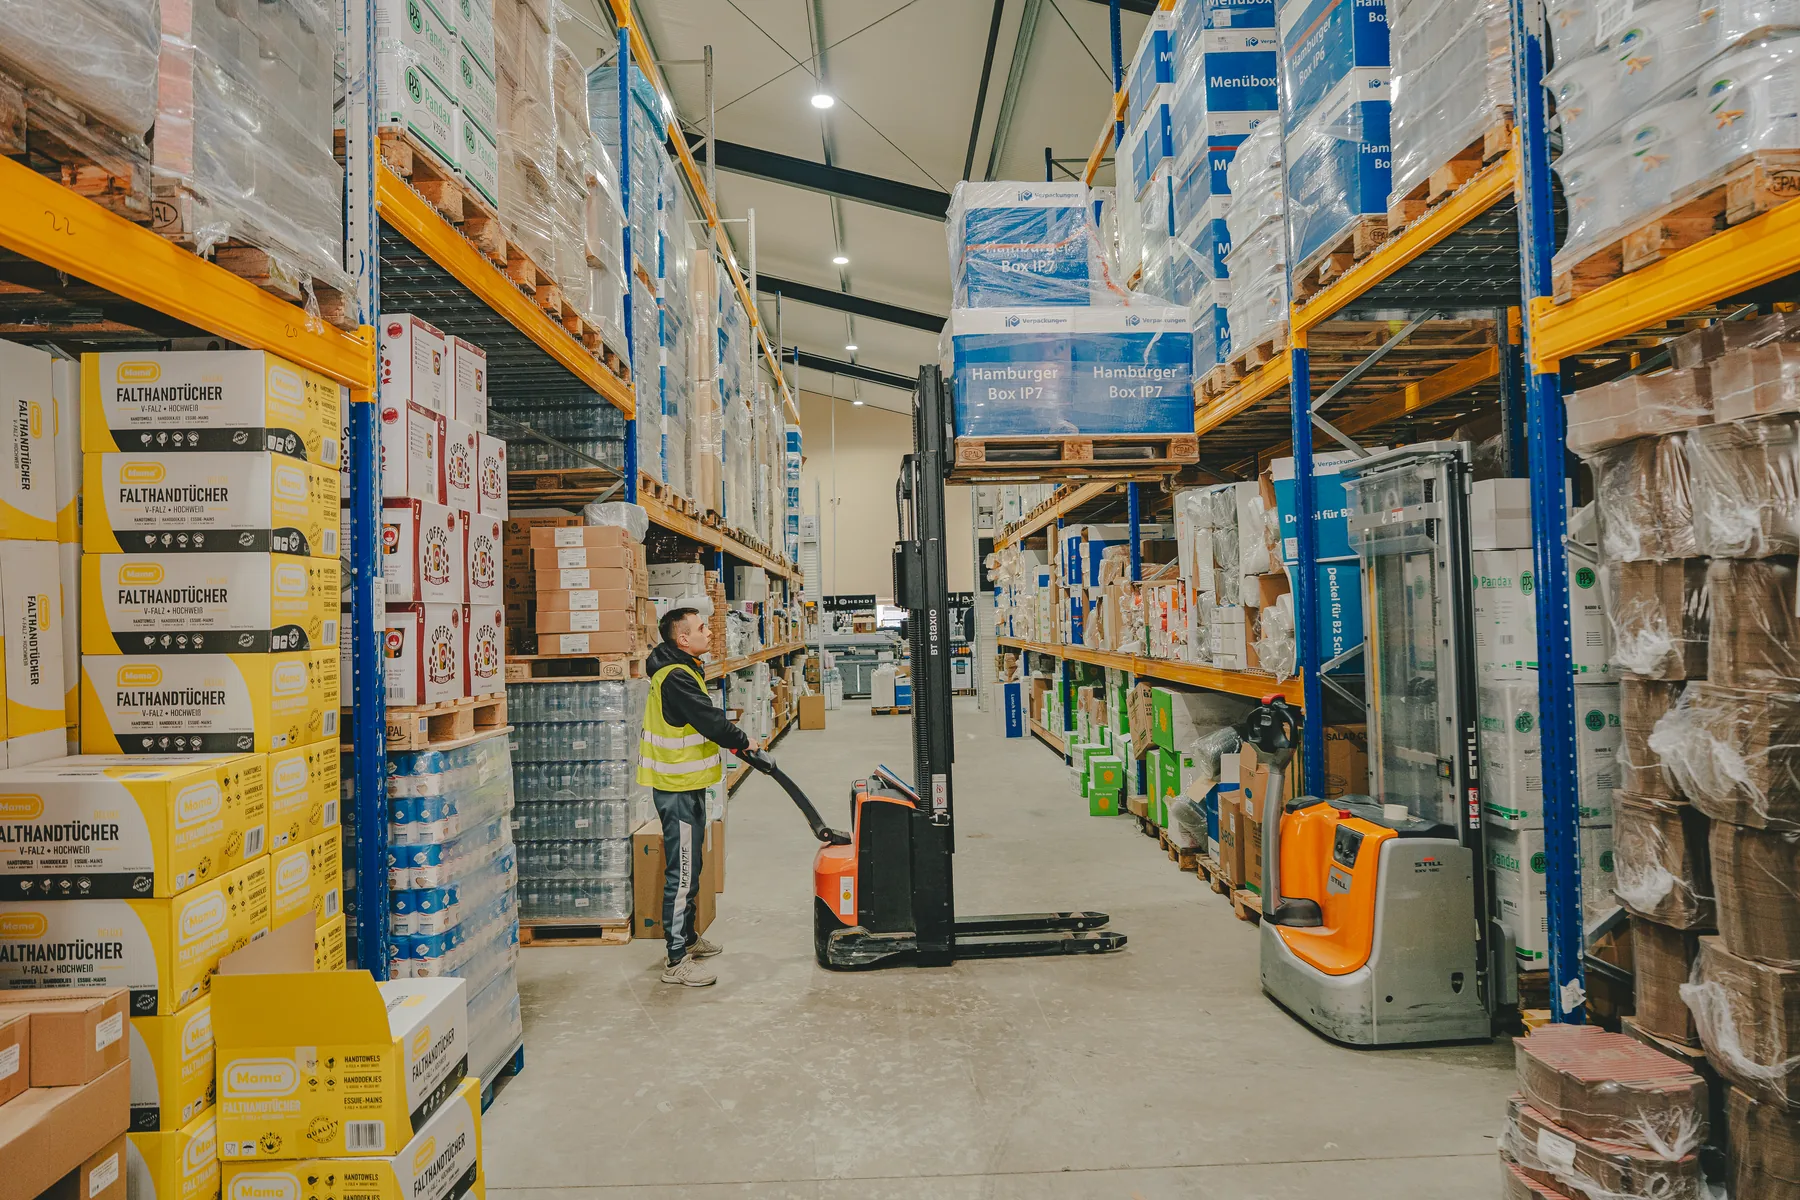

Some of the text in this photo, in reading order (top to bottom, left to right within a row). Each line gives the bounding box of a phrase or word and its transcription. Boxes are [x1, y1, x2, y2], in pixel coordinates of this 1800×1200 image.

[425, 20, 450, 58] Pandax
[1292, 16, 1332, 71] Hamburger
[1210, 74, 1276, 88] Menübox
[1299, 64, 1312, 86] Box
[425, 88, 451, 126] Pandax
[1375, 158, 1390, 168] Bo
[1002, 260, 1056, 272] Box IP7
[1022, 318, 1068, 326] Verpackungen
[284, 323, 298, 338] 20
[972, 366, 1058, 383] Hamburger
[1094, 366, 1178, 382] Hamburger
[116, 384, 222, 402] FALTHANDTÜCHER
[988, 386, 1043, 400] Box IP7
[1109, 386, 1163, 398] Box IP7
[18, 400, 32, 490] FALTHANDTÜCHER
[450, 442, 469, 460] COFFEE
[964, 450, 982, 458] EPAL
[484, 456, 500, 472] COFFEE
[120, 484, 228, 502] FALTHANDTÜCHER
[415, 504, 420, 514] 7
[1322, 508, 1338, 520] für
[464, 514, 468, 524] 7
[426, 526, 448, 548] COFFEE
[474, 535, 494, 554] COFFEE
[1482, 576, 1512, 587] Pandax
[118, 586, 228, 604] FALTHANDTÜCHER
[1327, 568, 1342, 634] Deckel für B2
[144, 607, 165, 615] V-FALZ
[418, 606, 422, 618] 7
[464, 608, 468, 618] 7
[431, 625, 454, 645] COFFEE
[476, 624, 496, 642] COFFEE
[27, 596, 40, 686] FALTHANDTÜCHER
[930, 646, 938, 656] BT
[125, 672, 154, 680] Mama
[116, 688, 226, 706] FALTHANDTÜCHER
[142, 709, 164, 717] V-FALZ
[386, 726, 404, 736] PAL
[1326, 732, 1356, 741] SALAD
[1466, 720, 1476, 780] STILL
[0, 820, 118, 843] ALTHANDTÜCHER
[20, 846, 44, 855] V-FALZ
[680, 846, 689, 888] MCKENZIE
[1330, 876, 1348, 890] STILL
[0, 939, 122, 962] ALTHANDTÜCHER
[22, 964, 94, 974] V-FALZ HOCHWEIß
[412, 1028, 455, 1082] FALTHANDTÜCHER
[236, 1072, 285, 1084] Mama
[344, 1076, 382, 1084] HANDDOEKJES
[222, 1098, 301, 1114] FALTHANDTÜCHER
[344, 1096, 382, 1105] ESSUIE-MAINS
[306, 1120, 339, 1138] QUALITY
[413, 1132, 466, 1198] FALTHANDTÜCHER
[241, 1186, 286, 1198] Mama
